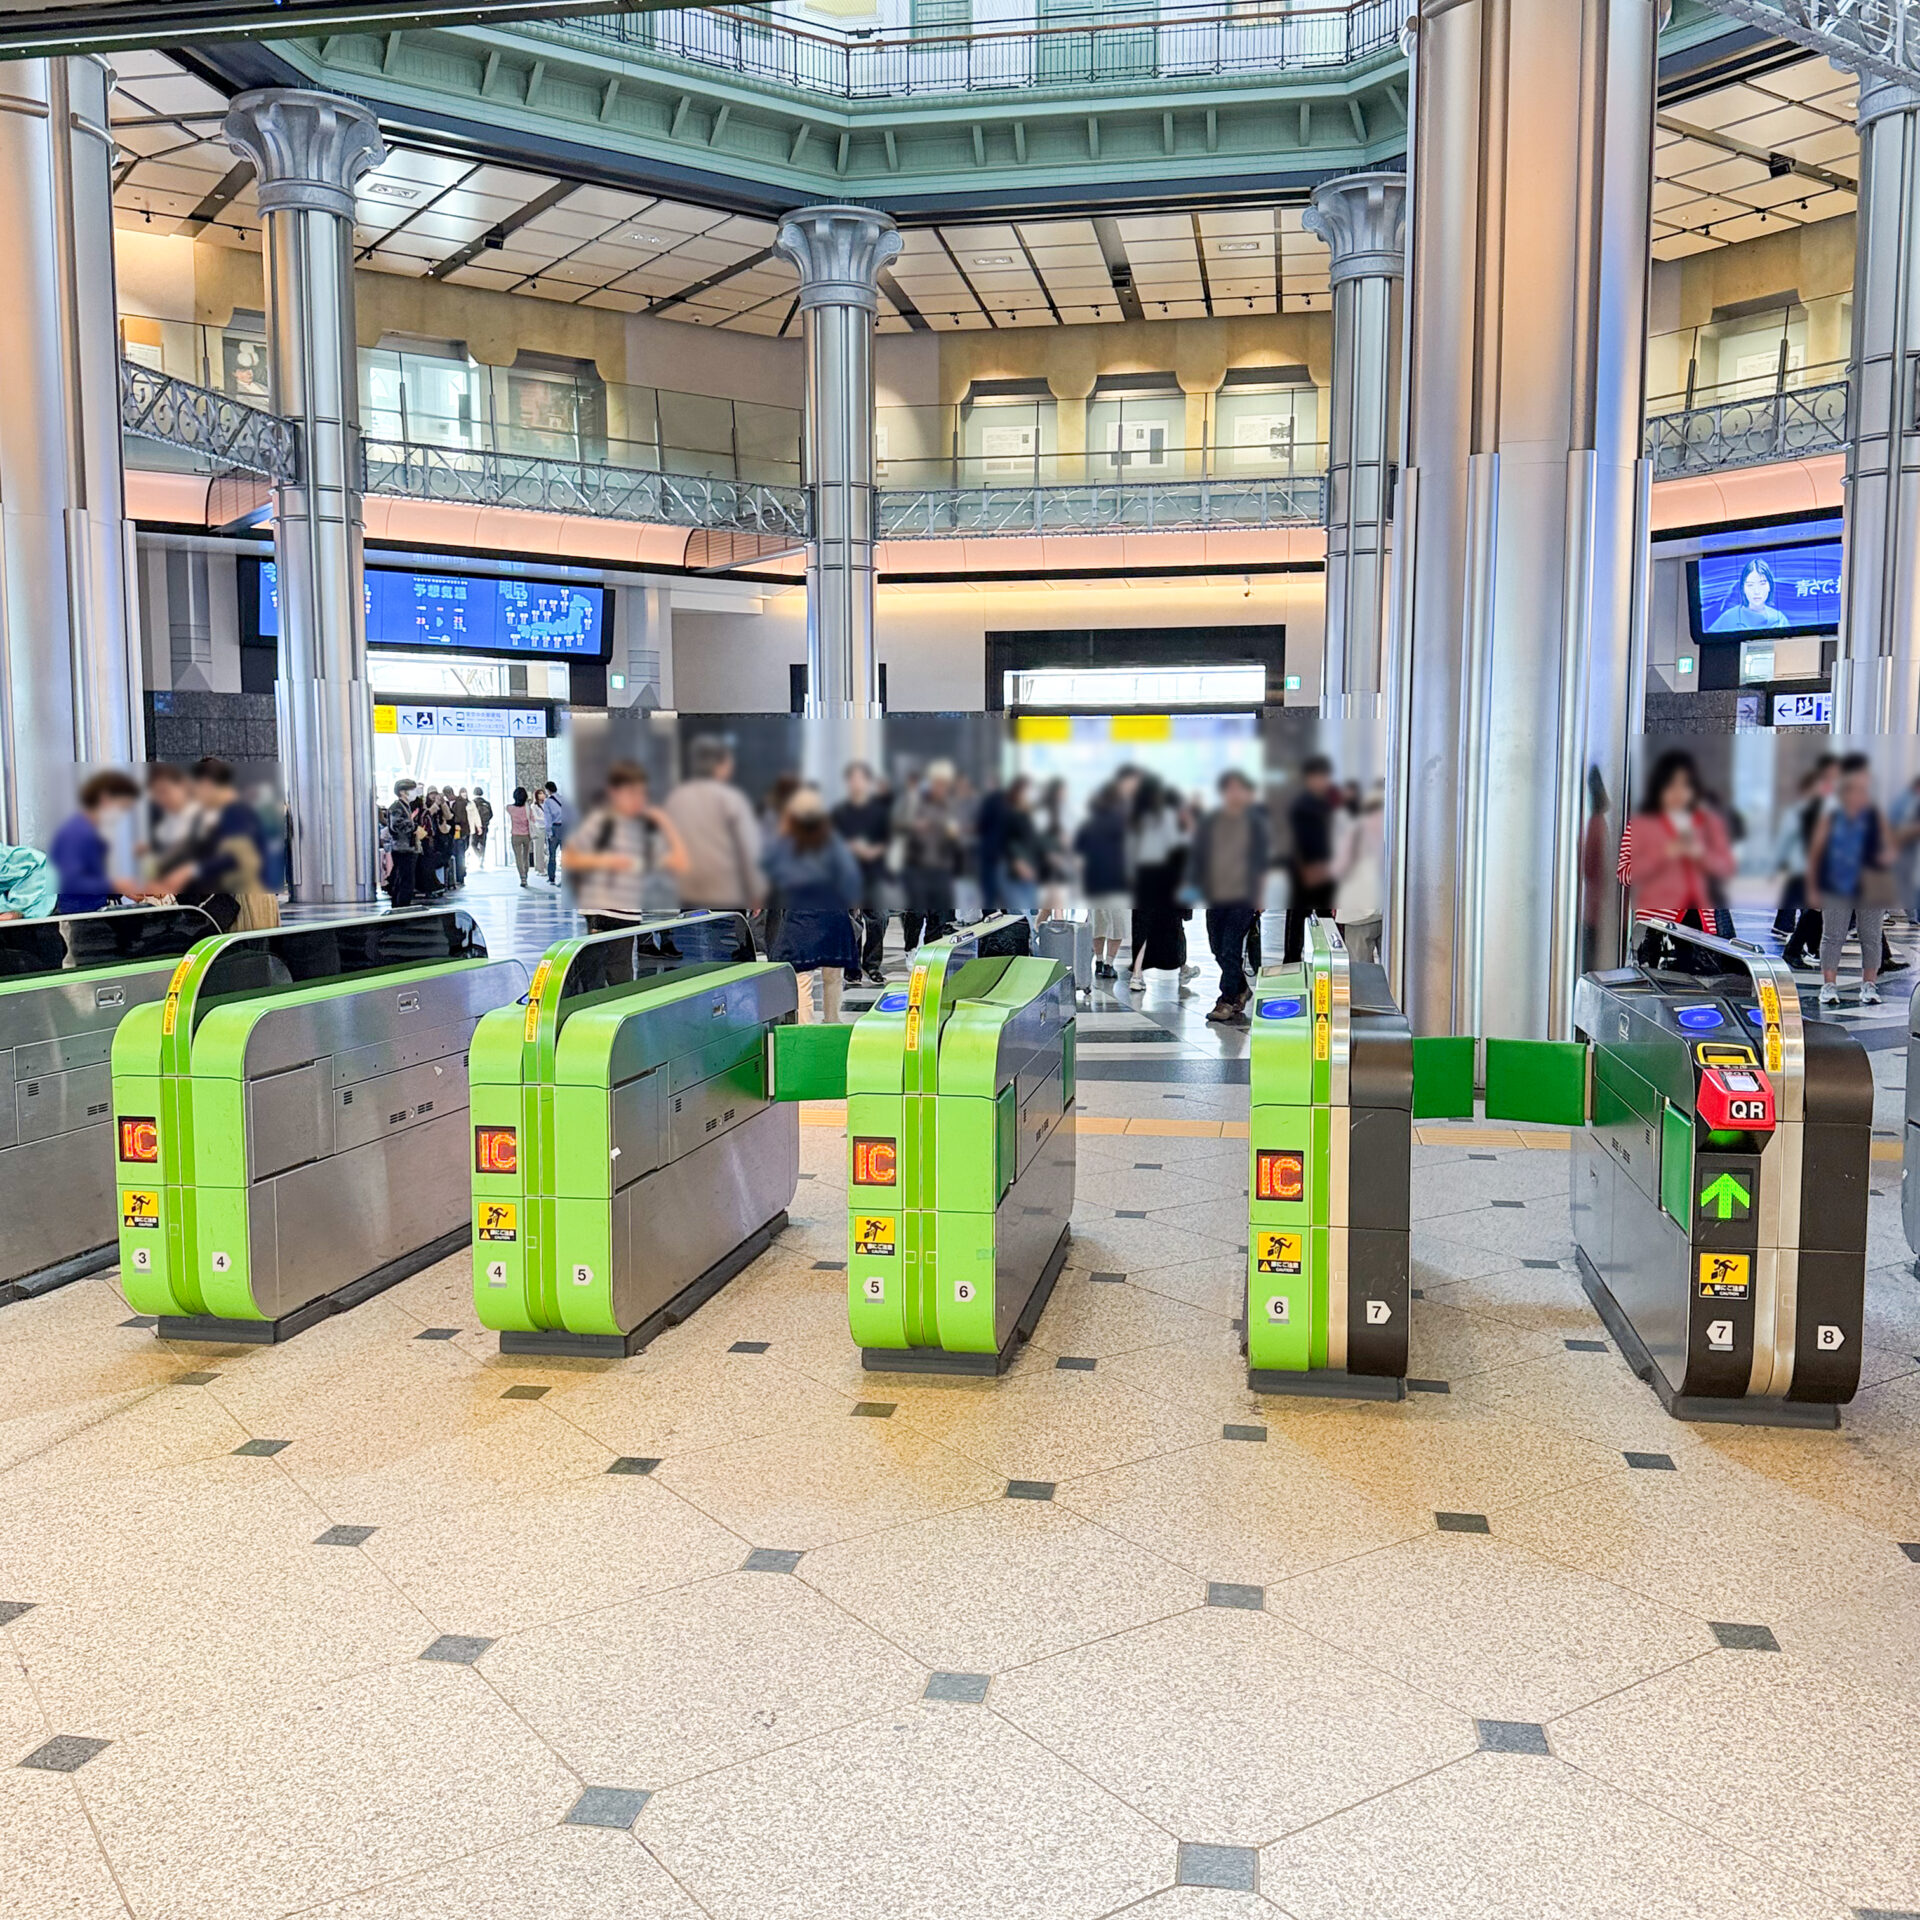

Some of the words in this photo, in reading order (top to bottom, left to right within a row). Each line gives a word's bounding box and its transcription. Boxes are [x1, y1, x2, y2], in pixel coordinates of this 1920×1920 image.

[413, 584, 467, 600] 予想気温
[1731, 1101, 1764, 1119] QR
[124, 1123, 158, 1158] IC
[481, 1132, 516, 1169] IC
[857, 1144, 895, 1182] IC
[1260, 1157, 1302, 1196] IC
[139, 1251, 147, 1264] 3
[217, 1256, 225, 1268] 4
[494, 1265, 502, 1278] 4
[578, 1268, 587, 1281] 5
[870, 1280, 880, 1294] 5
[959, 1285, 969, 1299] 6
[1273, 1301, 1284, 1315] 6
[1372, 1305, 1382, 1319] 7
[1716, 1325, 1727, 1339] 7
[1823, 1330, 1835, 1345] 8
